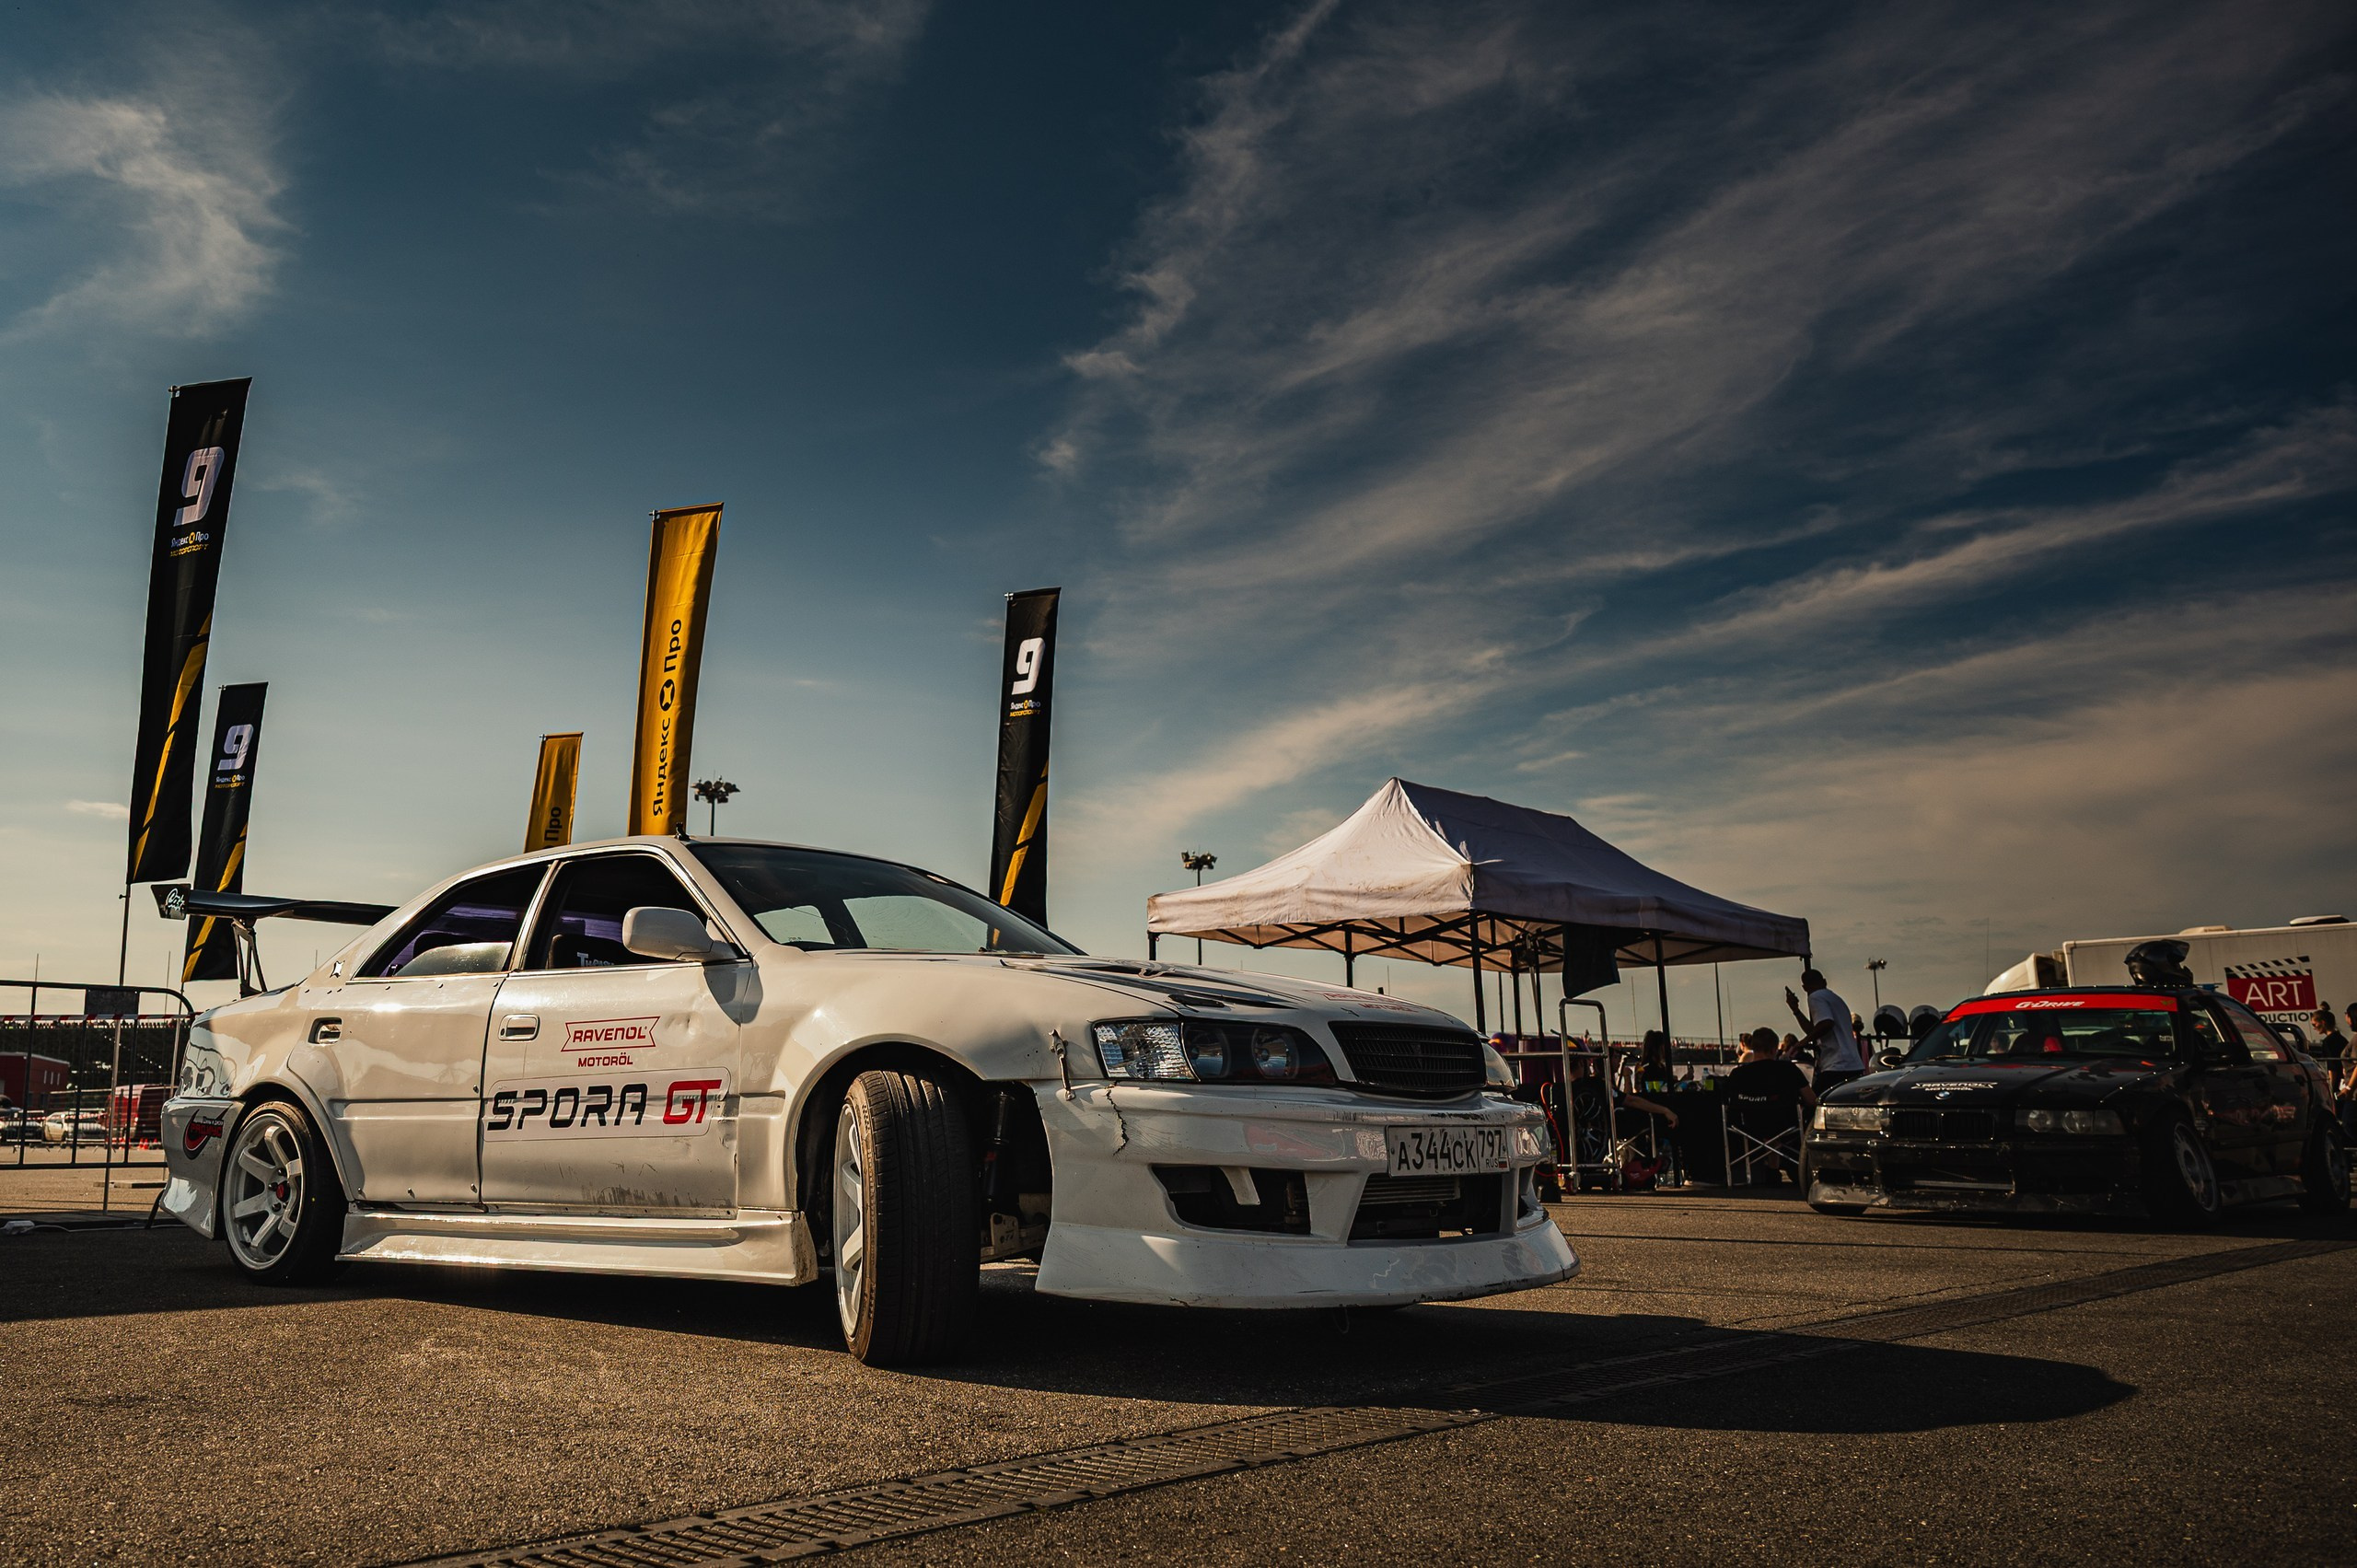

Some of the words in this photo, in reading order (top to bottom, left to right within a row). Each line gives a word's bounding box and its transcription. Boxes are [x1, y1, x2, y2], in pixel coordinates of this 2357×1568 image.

[173, 447, 225, 527] 9
[1011, 637, 1046, 695] 9
[654, 718, 670, 816] Яндекс
[664, 619, 682, 673] Про
[217, 724, 254, 771] 9
[544, 807, 563, 841] Про
[2245, 981, 2303, 1007] ART
[2260, 1012, 2313, 1023] DUCTIO
[573, 1027, 645, 1042] RAVENOL
[577, 1051, 633, 1067] MOTORÖL
[487, 1083, 648, 1131] SPORA
[663, 1079, 722, 1124] GT
[1478, 1130, 1502, 1157] 797
[1485, 1158, 1499, 1167] RUS
